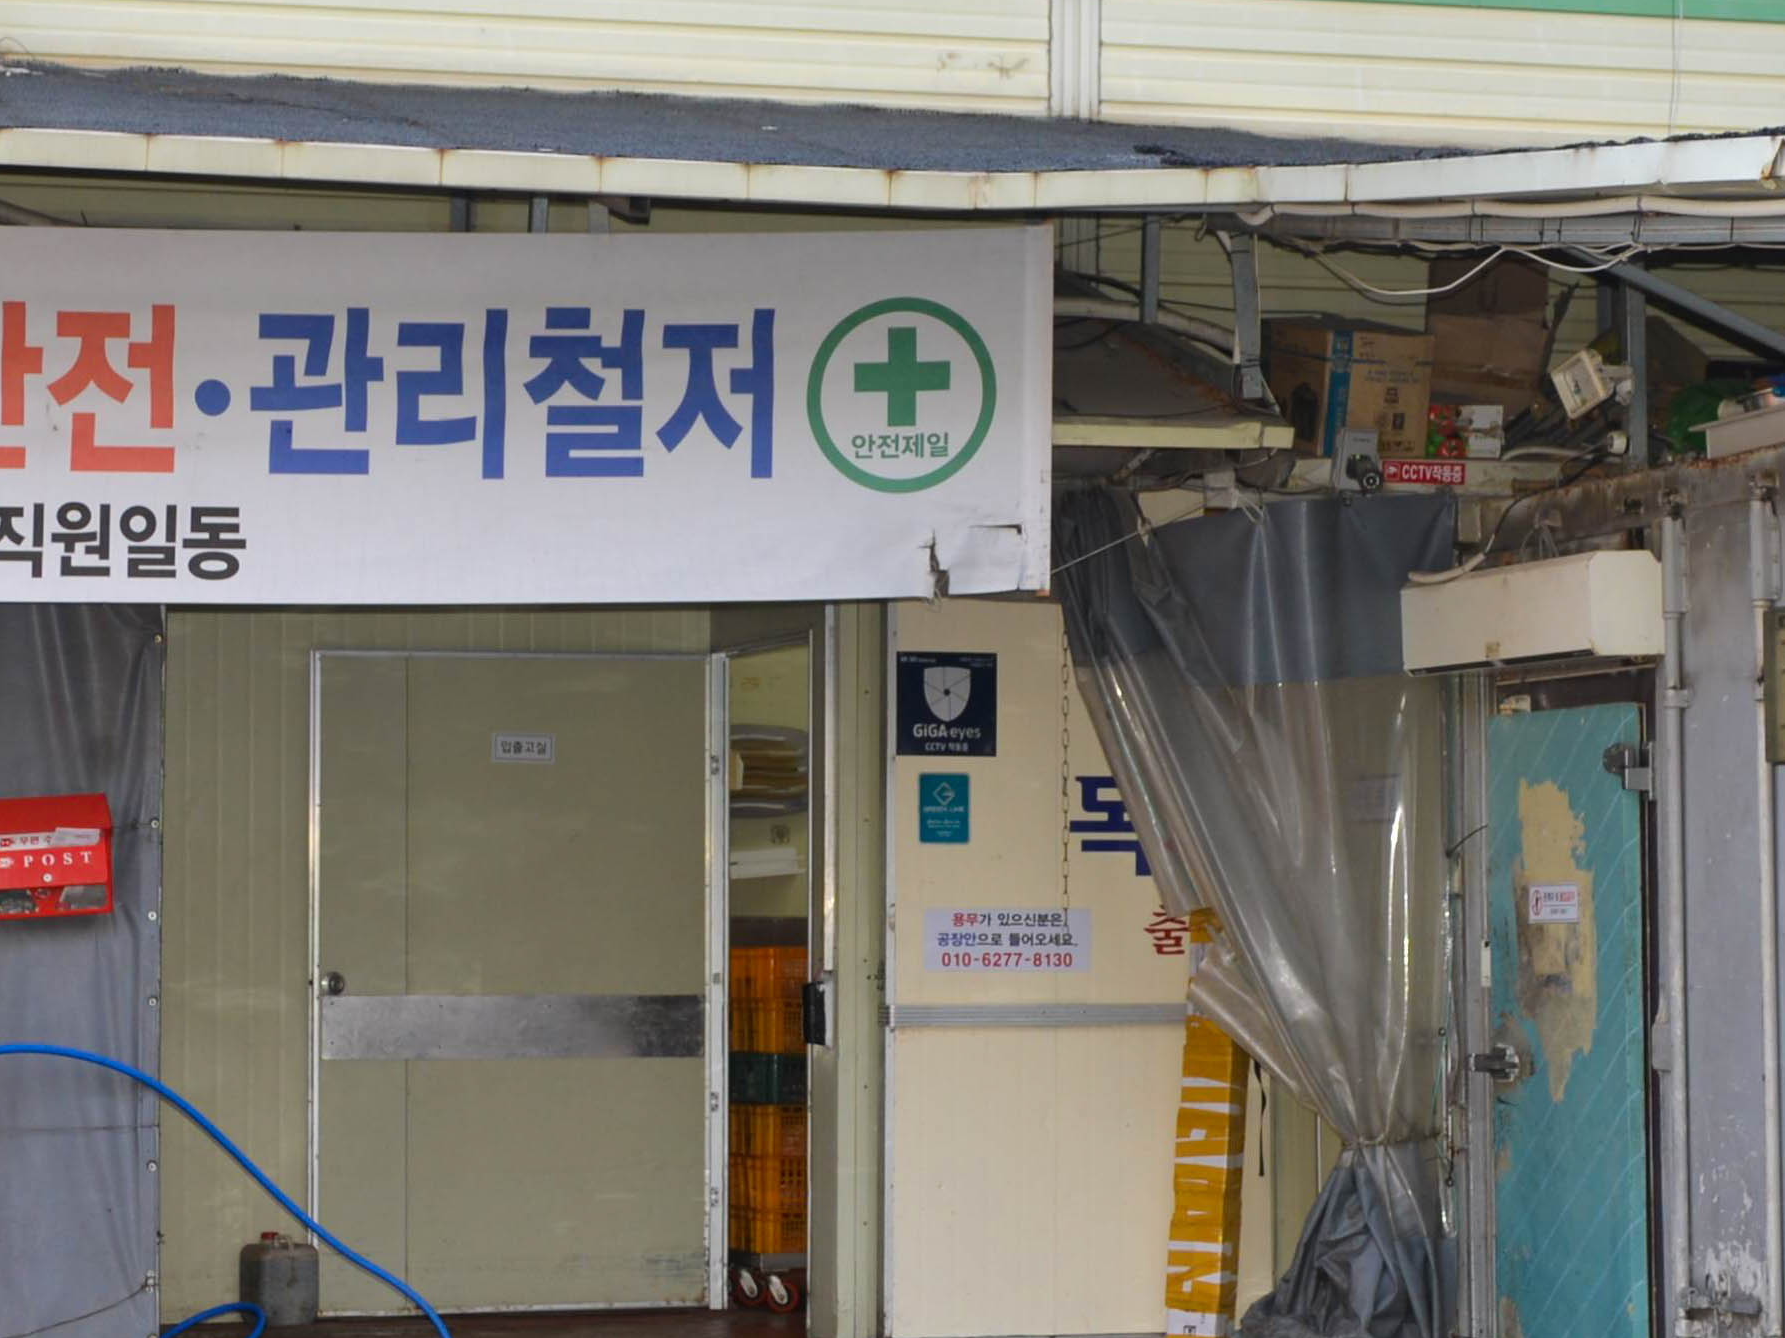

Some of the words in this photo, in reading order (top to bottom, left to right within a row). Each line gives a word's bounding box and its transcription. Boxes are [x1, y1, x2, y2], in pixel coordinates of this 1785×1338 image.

[851, 431, 951, 460] 안전제일
[949, 727, 982, 741] eyes
[23, 850, 92, 869] POST
[952, 912, 992, 928] 용무가
[937, 932, 1004, 947] 공장안으로
[941, 951, 1073, 968] 010-6277-8130
